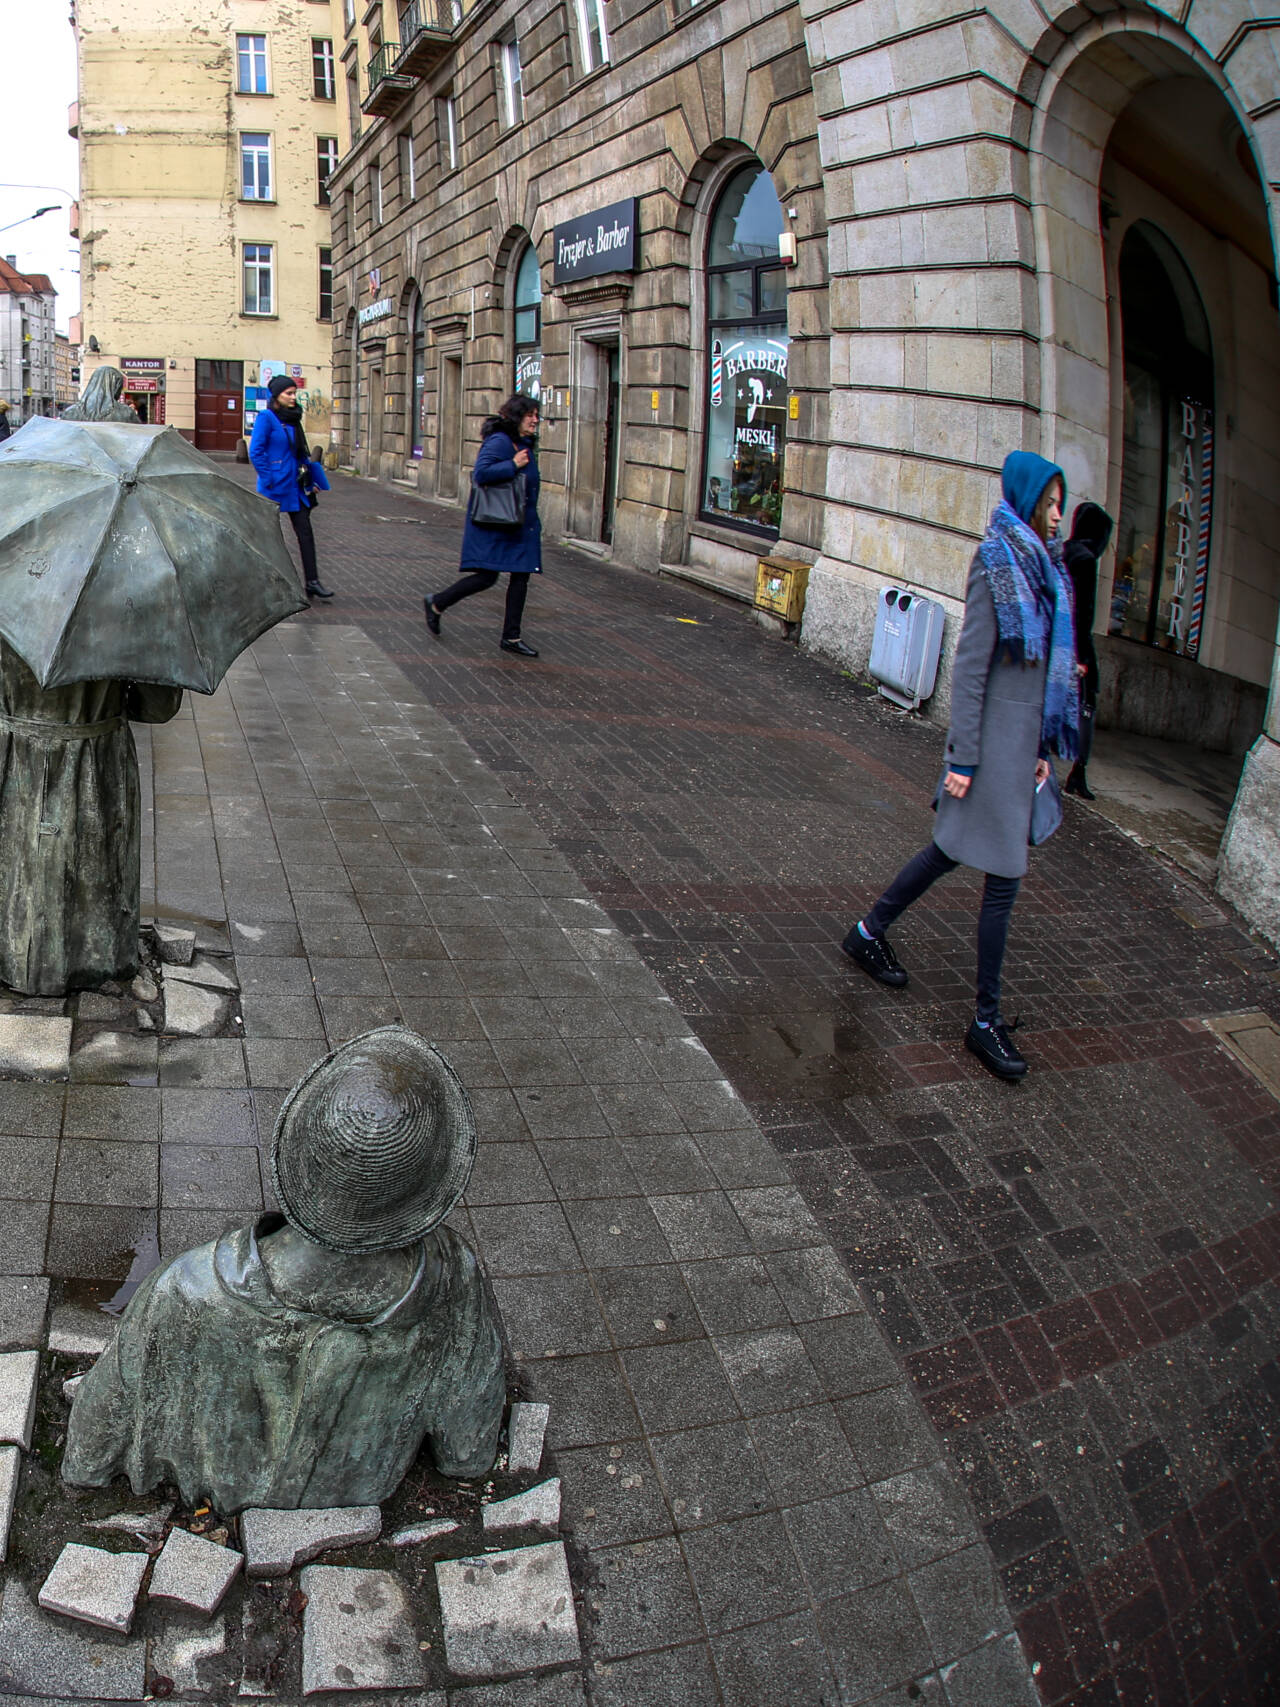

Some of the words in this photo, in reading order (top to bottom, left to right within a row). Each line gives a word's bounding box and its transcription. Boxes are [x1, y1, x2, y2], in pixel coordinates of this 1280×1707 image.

[557, 233, 587, 270] Fryzjer
[586, 236, 595, 257] &
[595, 219, 630, 254] Barber
[124, 360, 161, 369] KANTOR
[724, 348, 788, 380] BARBER
[736, 426, 772, 447] MĘSKI
[1167, 400, 1198, 641] BARBER
